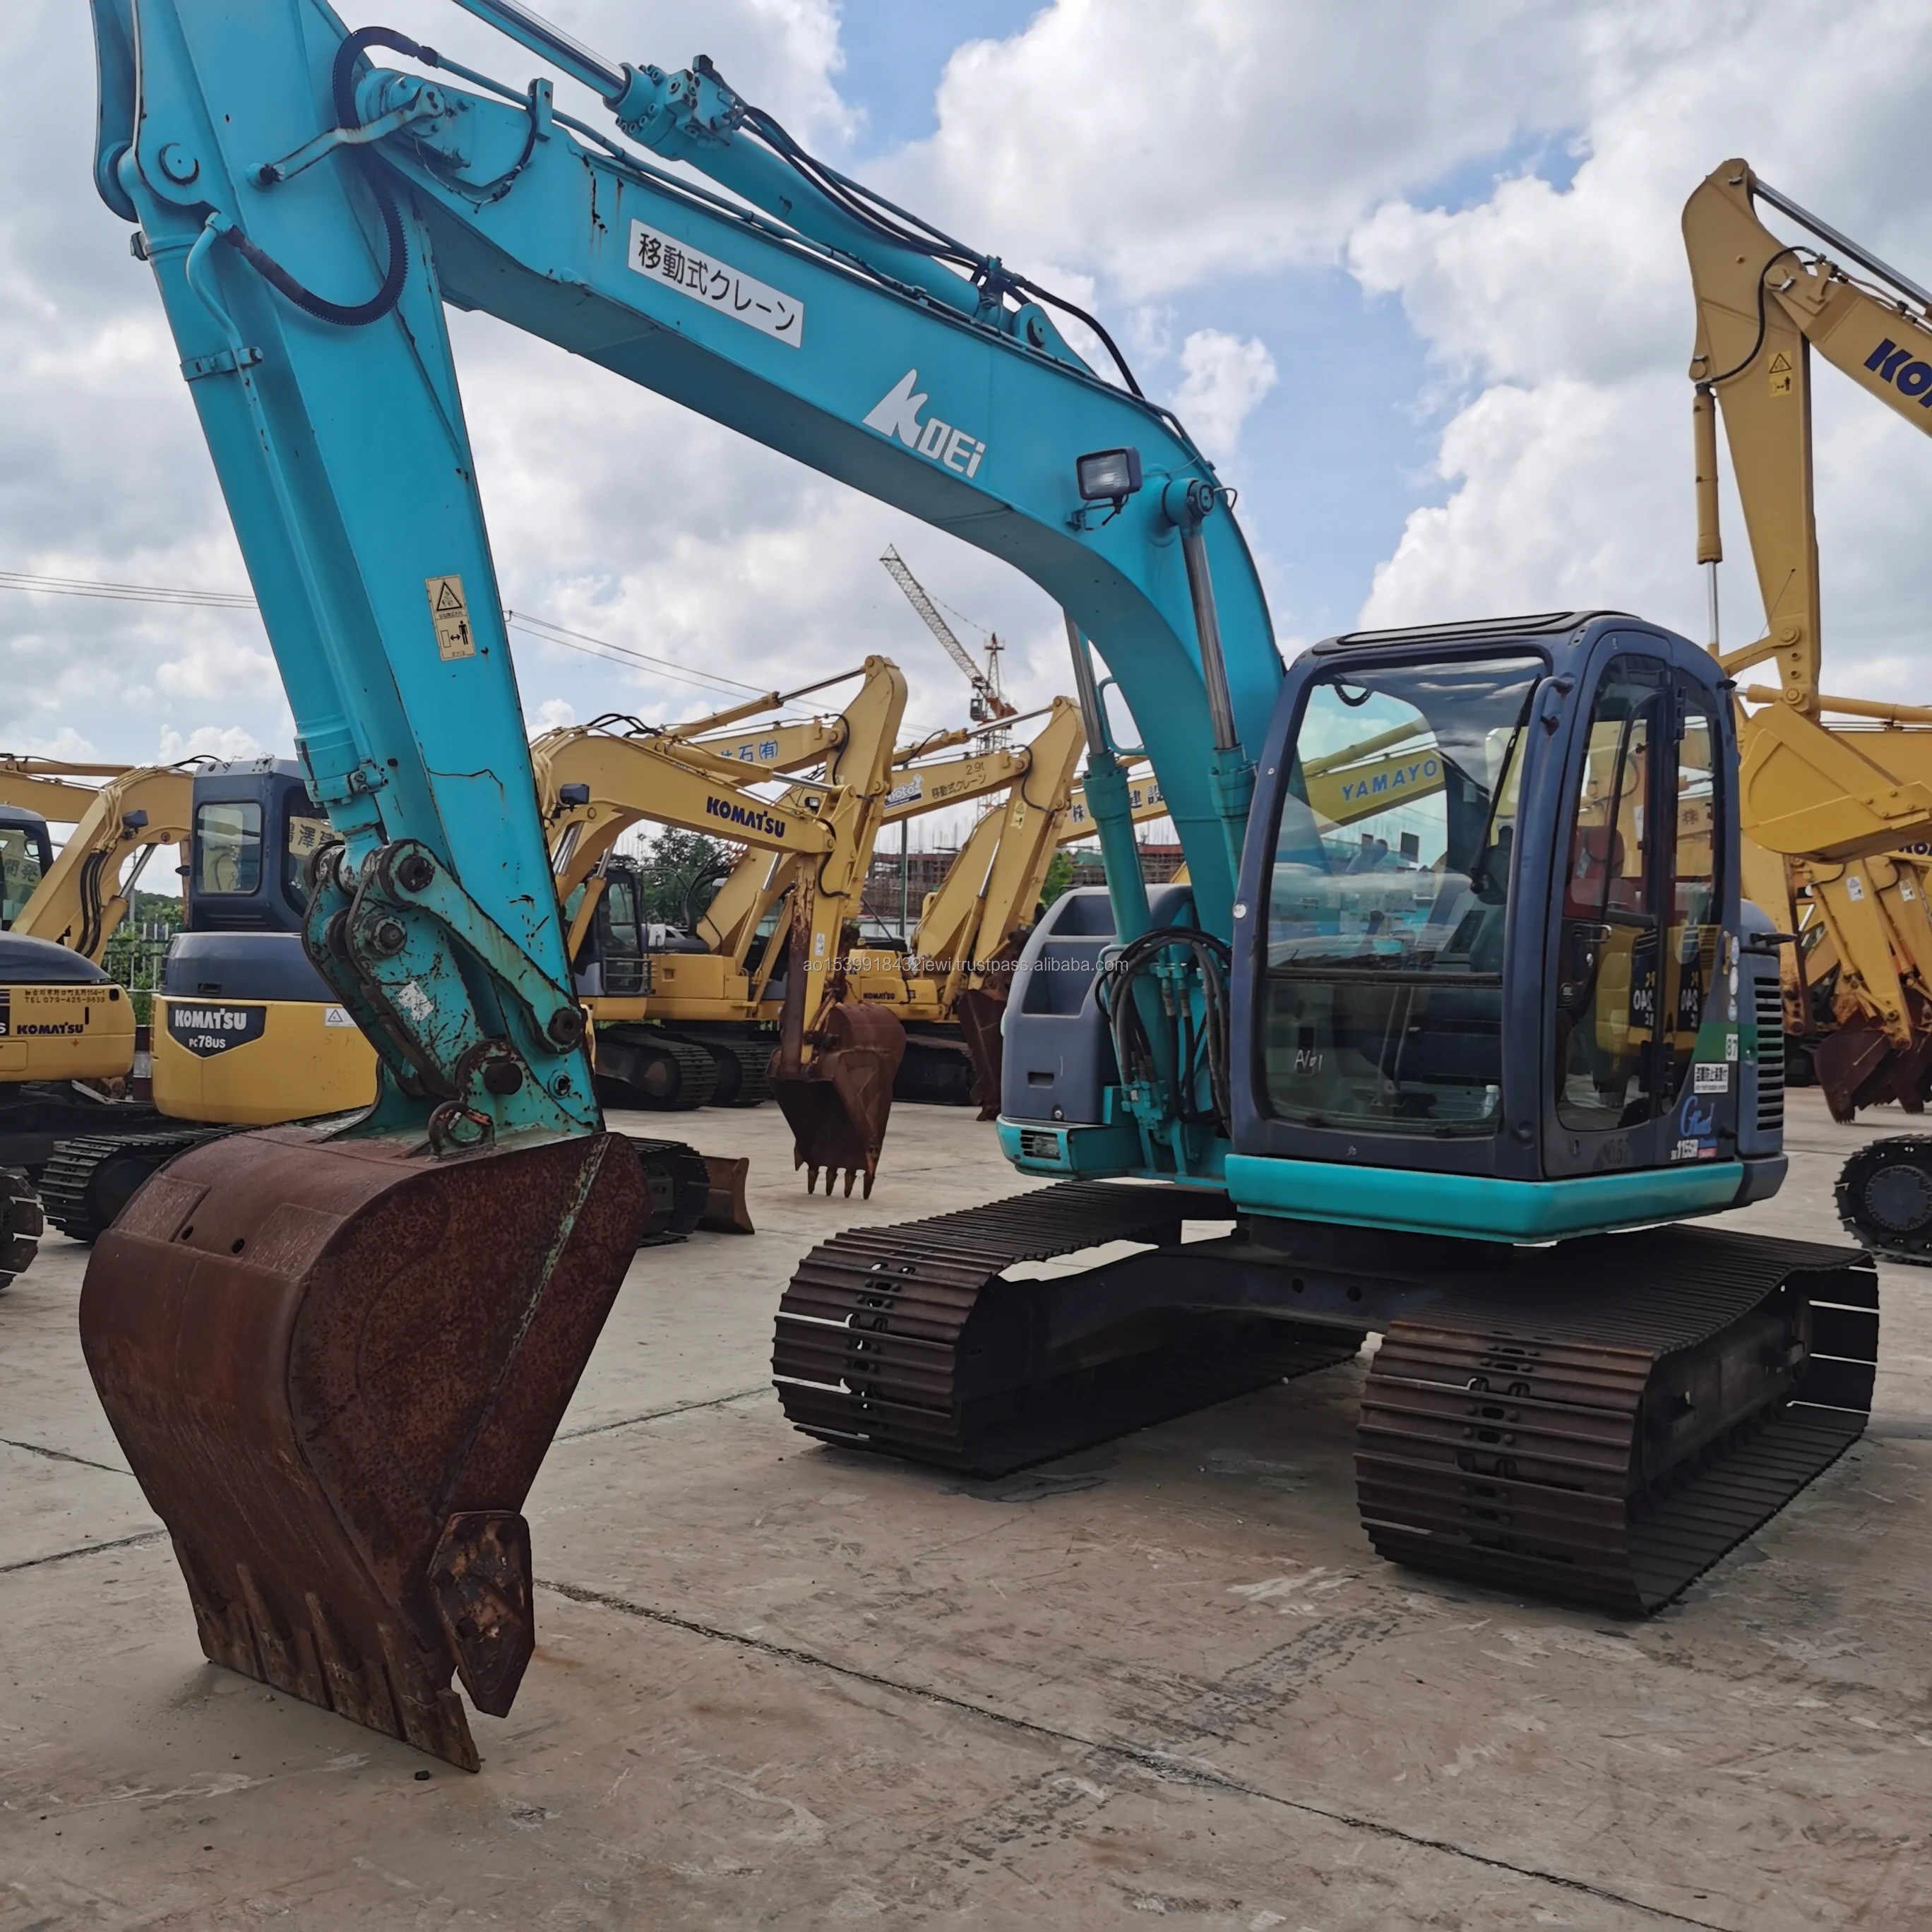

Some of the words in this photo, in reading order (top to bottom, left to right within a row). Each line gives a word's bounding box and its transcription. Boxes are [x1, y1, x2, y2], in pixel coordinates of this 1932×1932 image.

[638, 232, 795, 330] 移動式クレーン
[1863, 338, 1932, 408] KO
[931, 773, 986, 799] 移動式クレーン
[1342, 759, 1438, 801] YAMAYO
[706, 796, 785, 838] KOMATSU
[863, 991, 895, 1000] KOMATSU
[17, 1022, 83, 1034] KOMATSU
[174, 1008, 246, 1030] KOMATSU
[189, 1034, 226, 1049] PC78US
